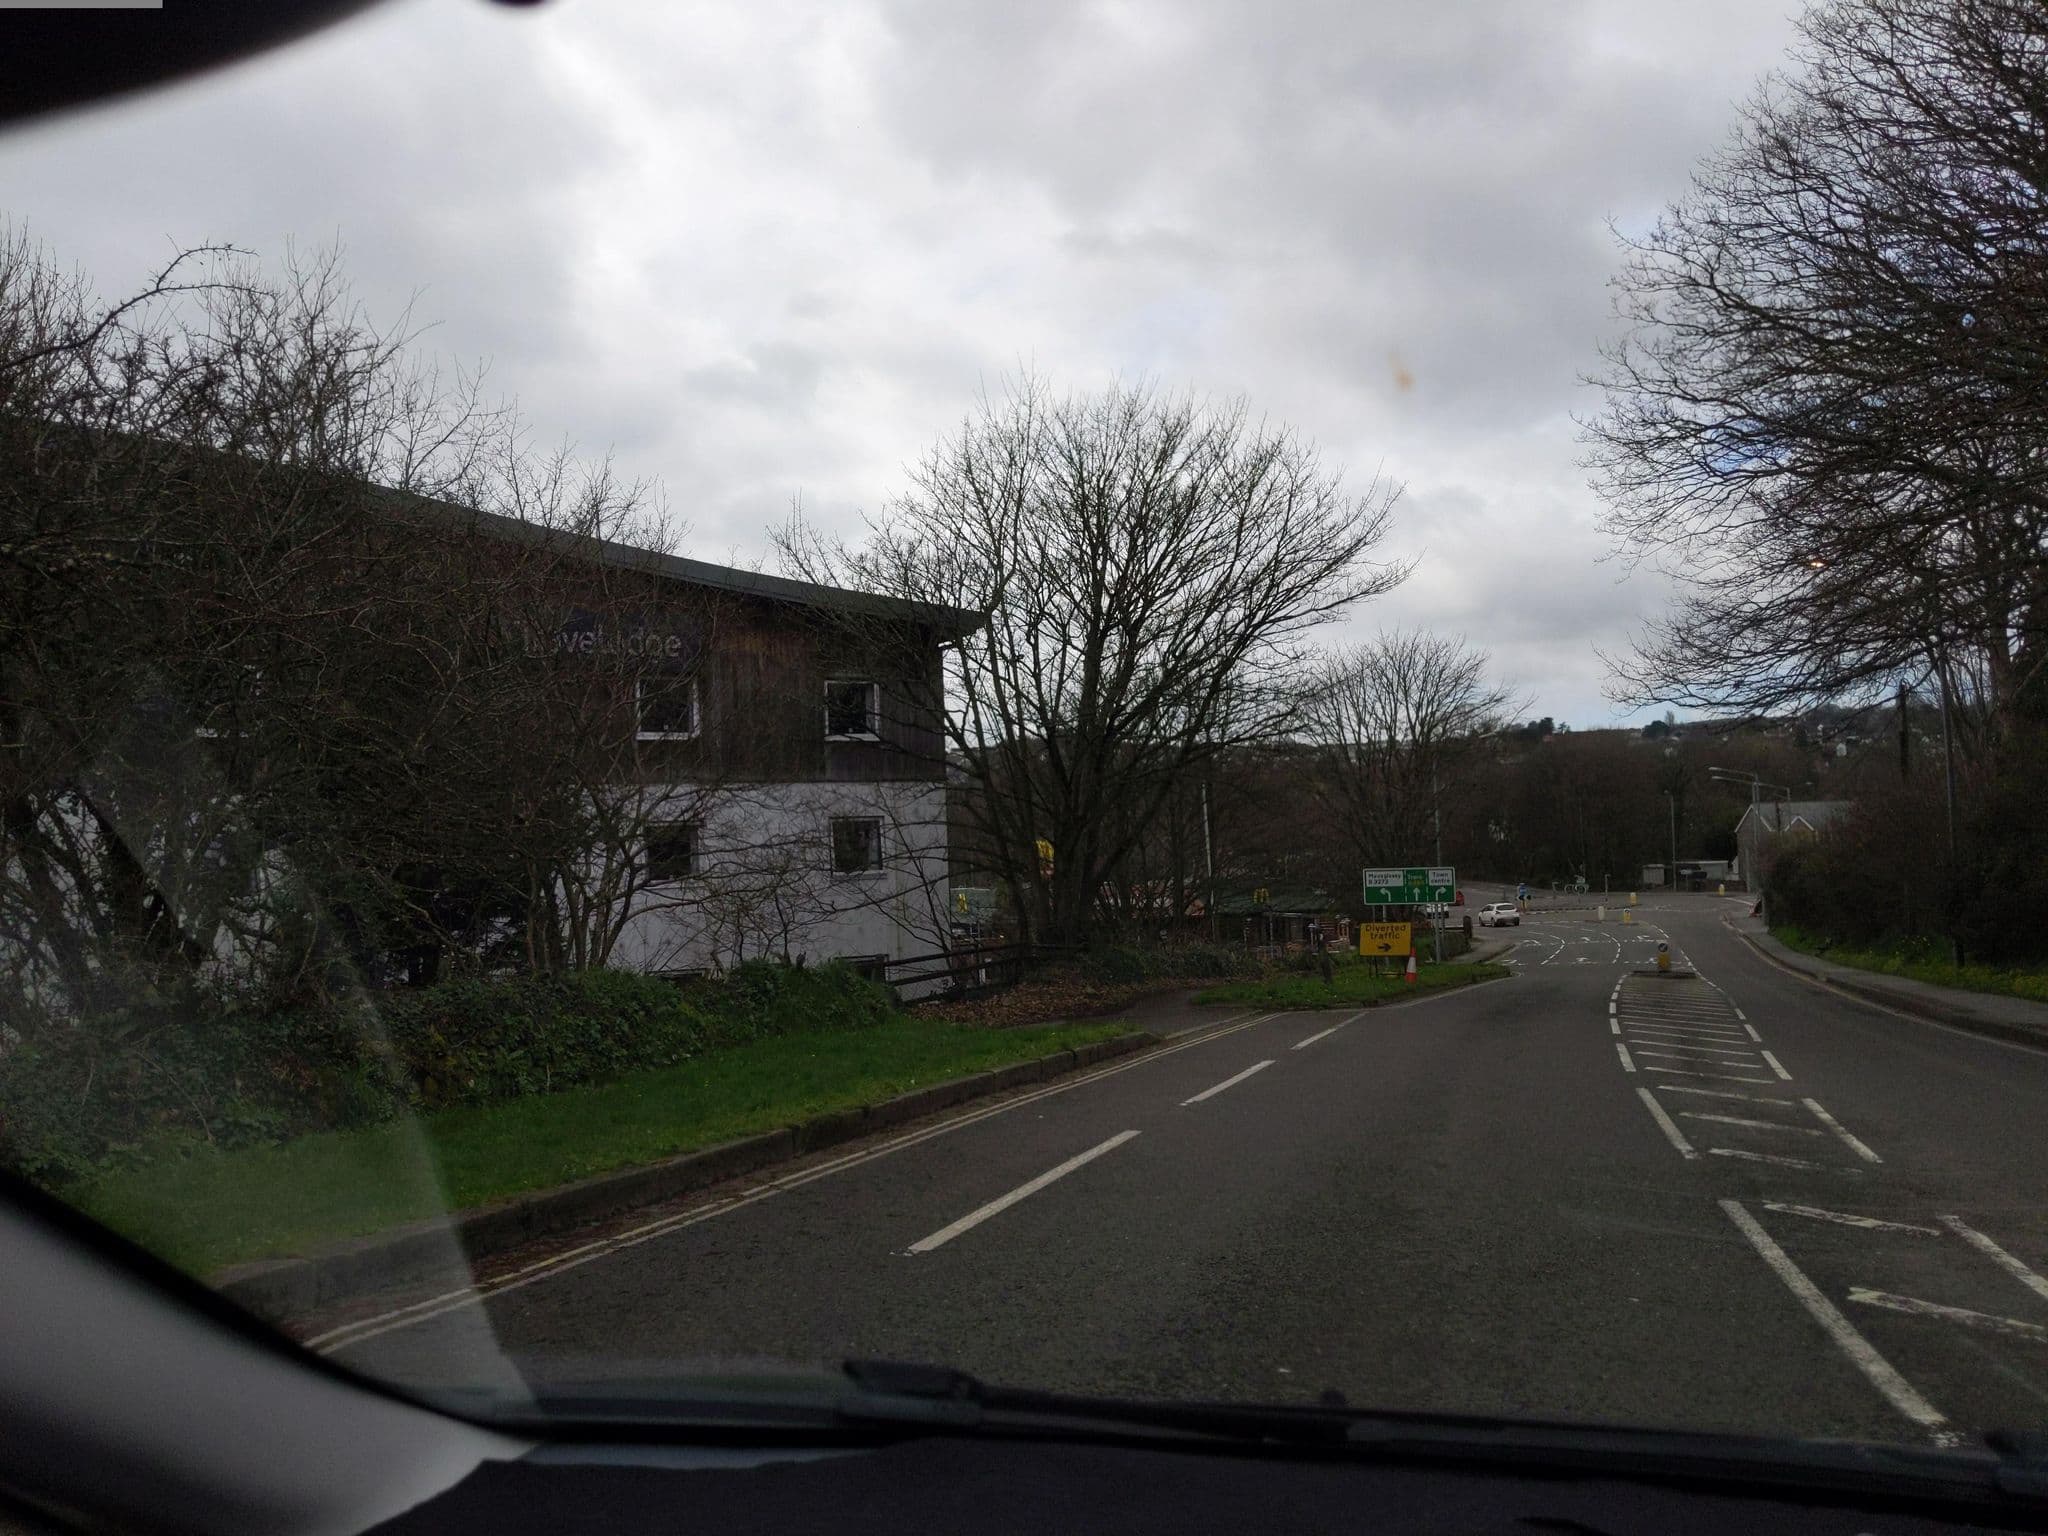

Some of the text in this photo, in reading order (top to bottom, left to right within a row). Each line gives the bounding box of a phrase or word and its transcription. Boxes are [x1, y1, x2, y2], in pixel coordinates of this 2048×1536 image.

[1432, 871, 1449, 879] Town
[1365, 924, 1406, 933] Diverted
[1370, 931, 1400, 939] traffic
